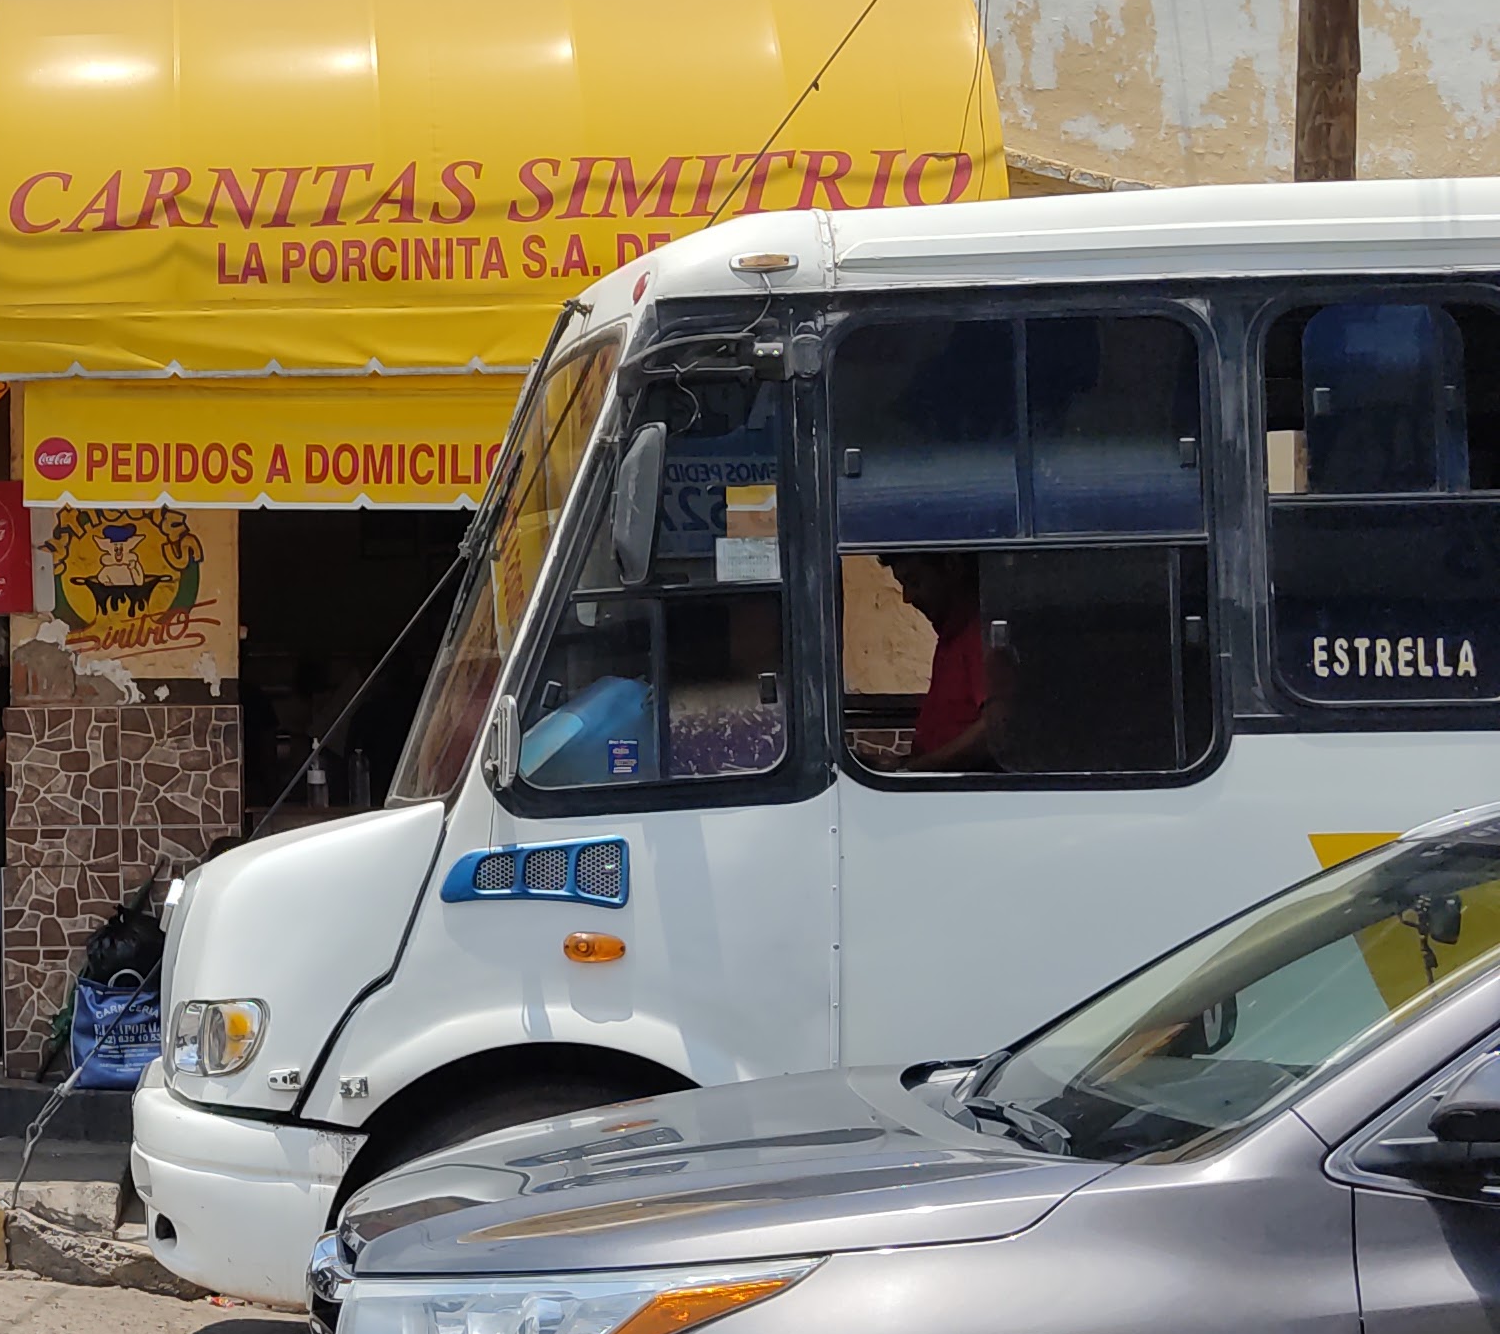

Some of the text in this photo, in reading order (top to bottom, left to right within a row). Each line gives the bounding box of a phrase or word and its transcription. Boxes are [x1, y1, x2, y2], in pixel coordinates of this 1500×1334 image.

[8, 149, 973, 234] CARNITAS SIMITRIO
[217, 242, 268, 285] LA
[281, 236, 510, 285] PORCINITA
[522, 233, 601, 279] S.A.
[85, 442, 254, 485] PEDIDOS
[265, 442, 292, 484] A
[1313, 636, 1478, 678] ESTRELLA
[95, 1002, 160, 1020] CARNCERIA
